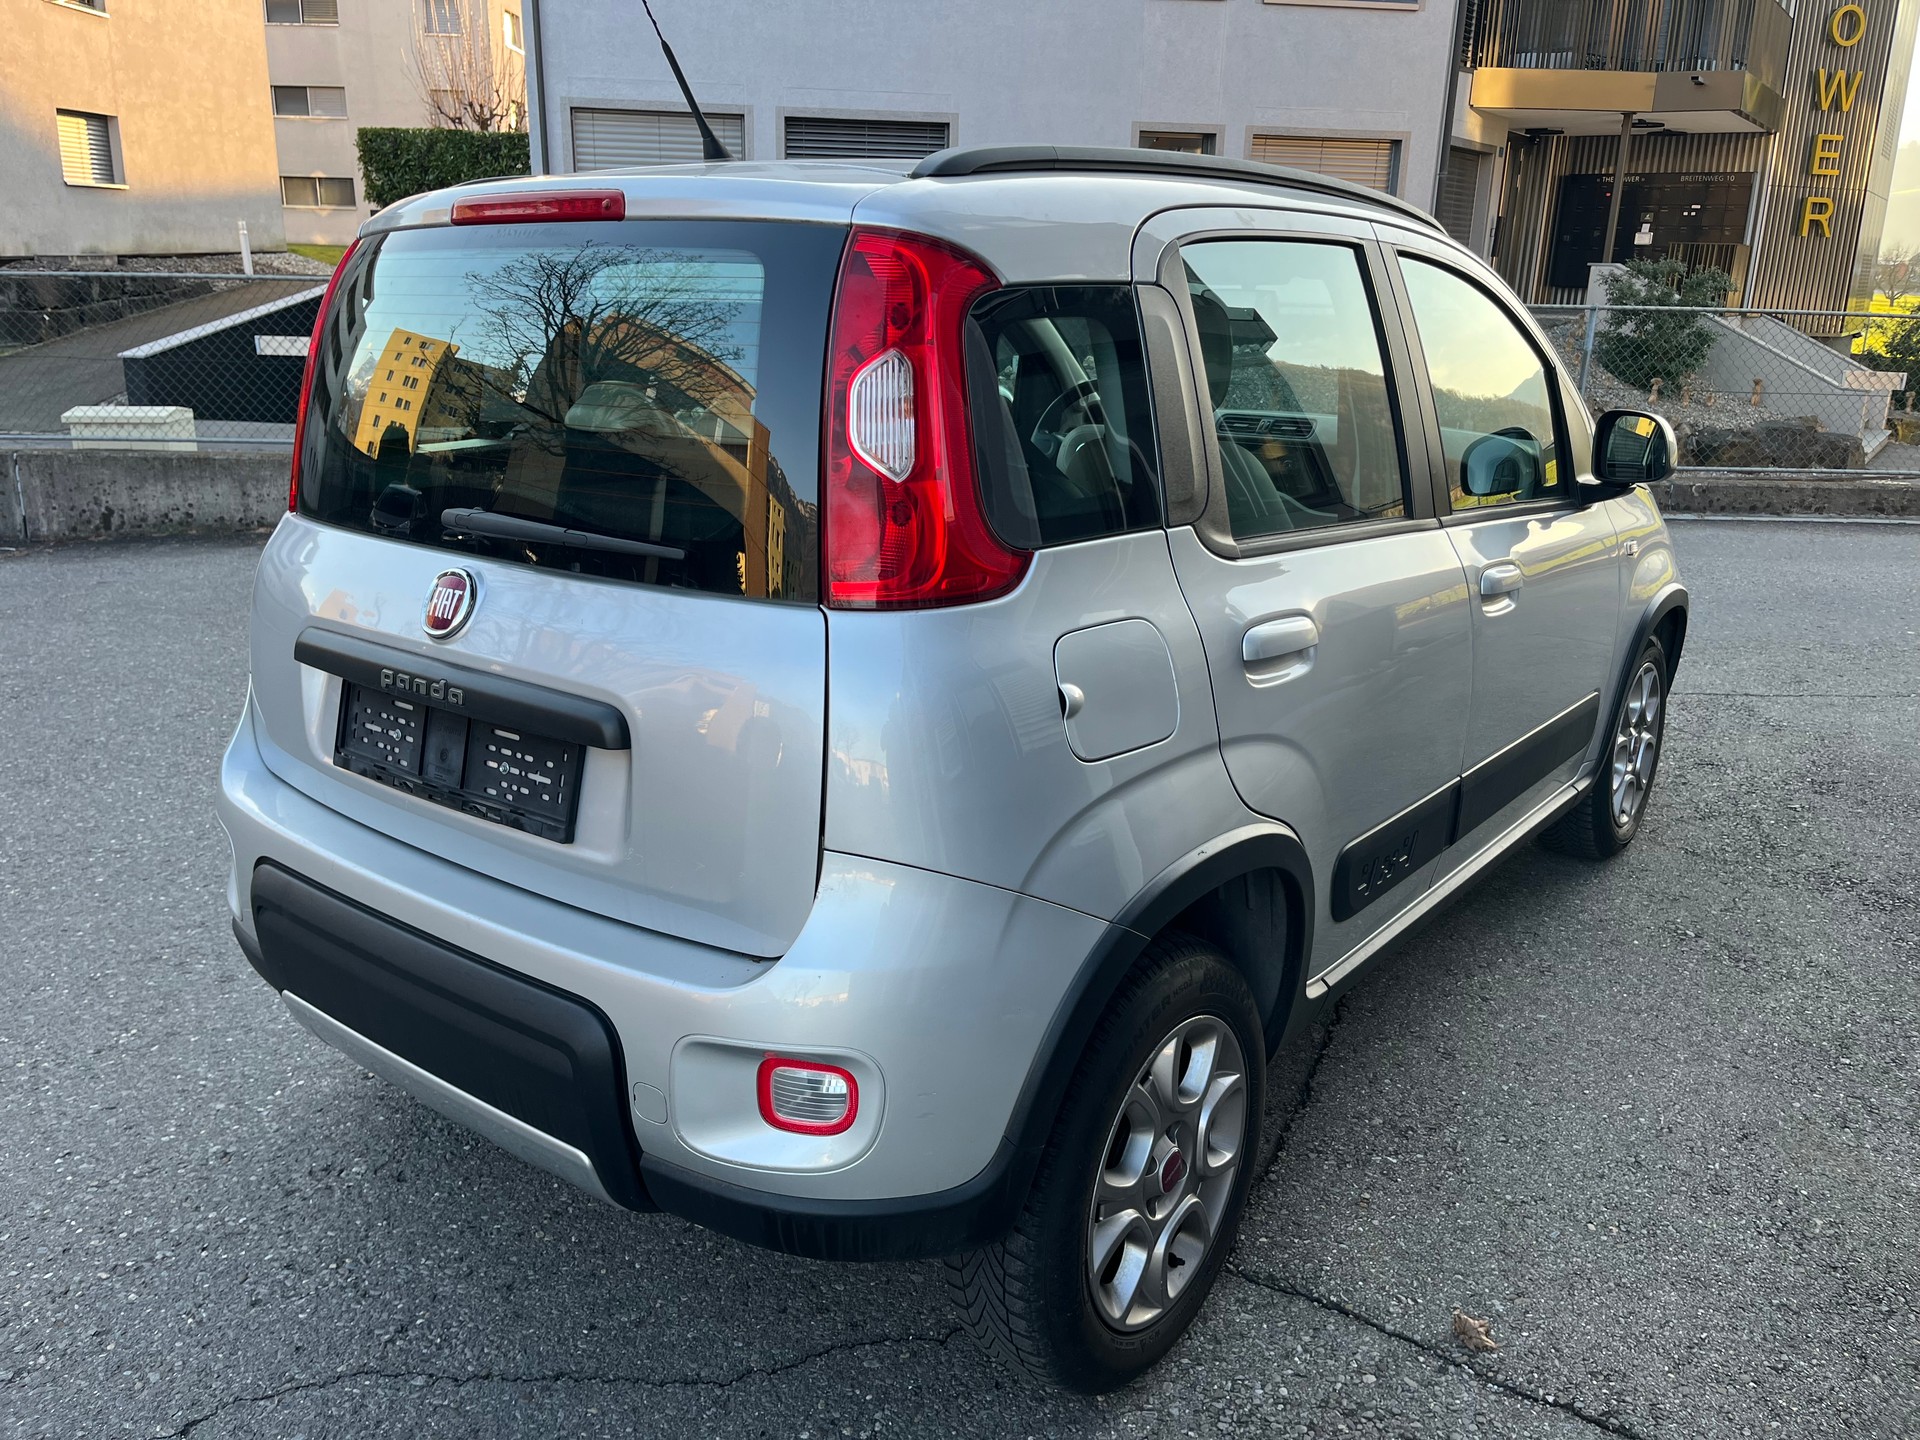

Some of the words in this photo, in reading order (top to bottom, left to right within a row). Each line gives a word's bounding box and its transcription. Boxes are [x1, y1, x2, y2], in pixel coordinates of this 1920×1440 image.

[1680, 174, 1724, 182] BREITENWEG
[1726, 174, 1736, 182] 10
[429, 586, 463, 620] FIAT
[380, 668, 464, 706] panda
